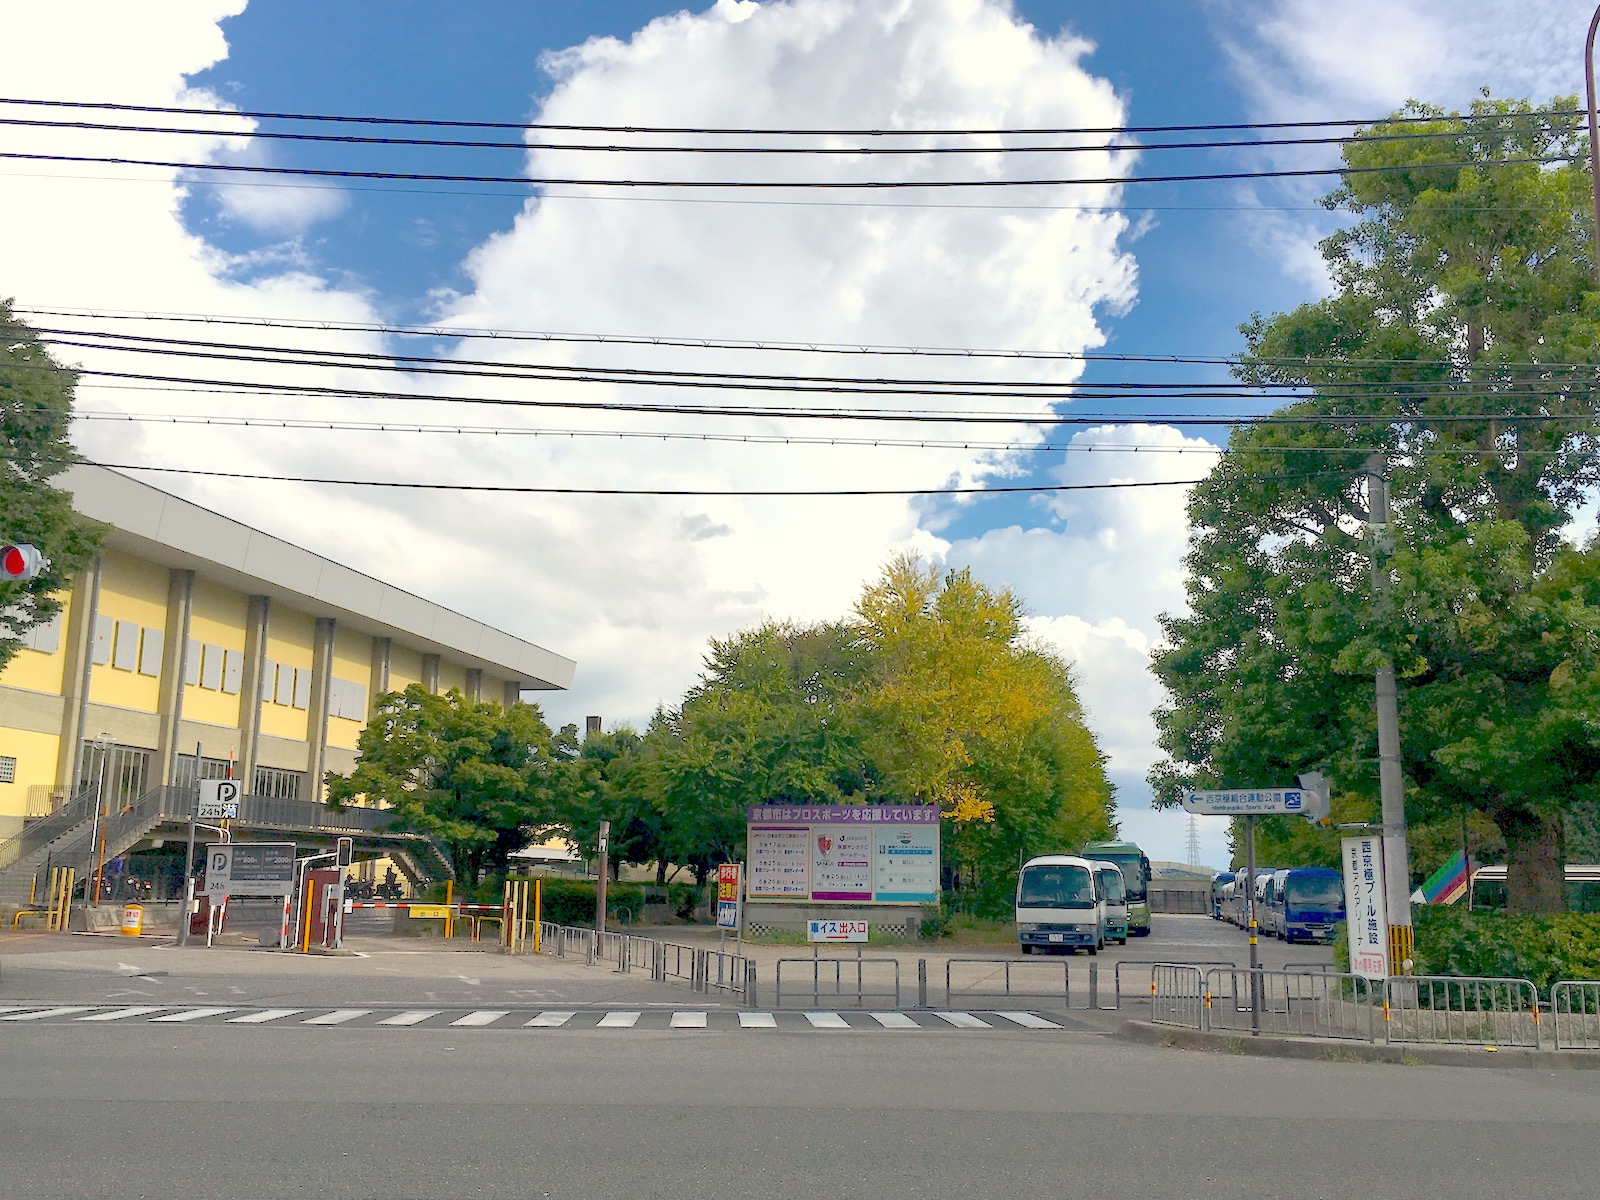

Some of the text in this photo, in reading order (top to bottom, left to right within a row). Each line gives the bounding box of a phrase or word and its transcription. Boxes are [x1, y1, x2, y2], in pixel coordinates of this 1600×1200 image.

[200, 808, 220, 816] 24h
[752, 807, 936, 822] 京都市はプロスポーツを応援しています。
[210, 882, 225, 890] 24h
[1361, 841, 1380, 945] 西京極プール施設
